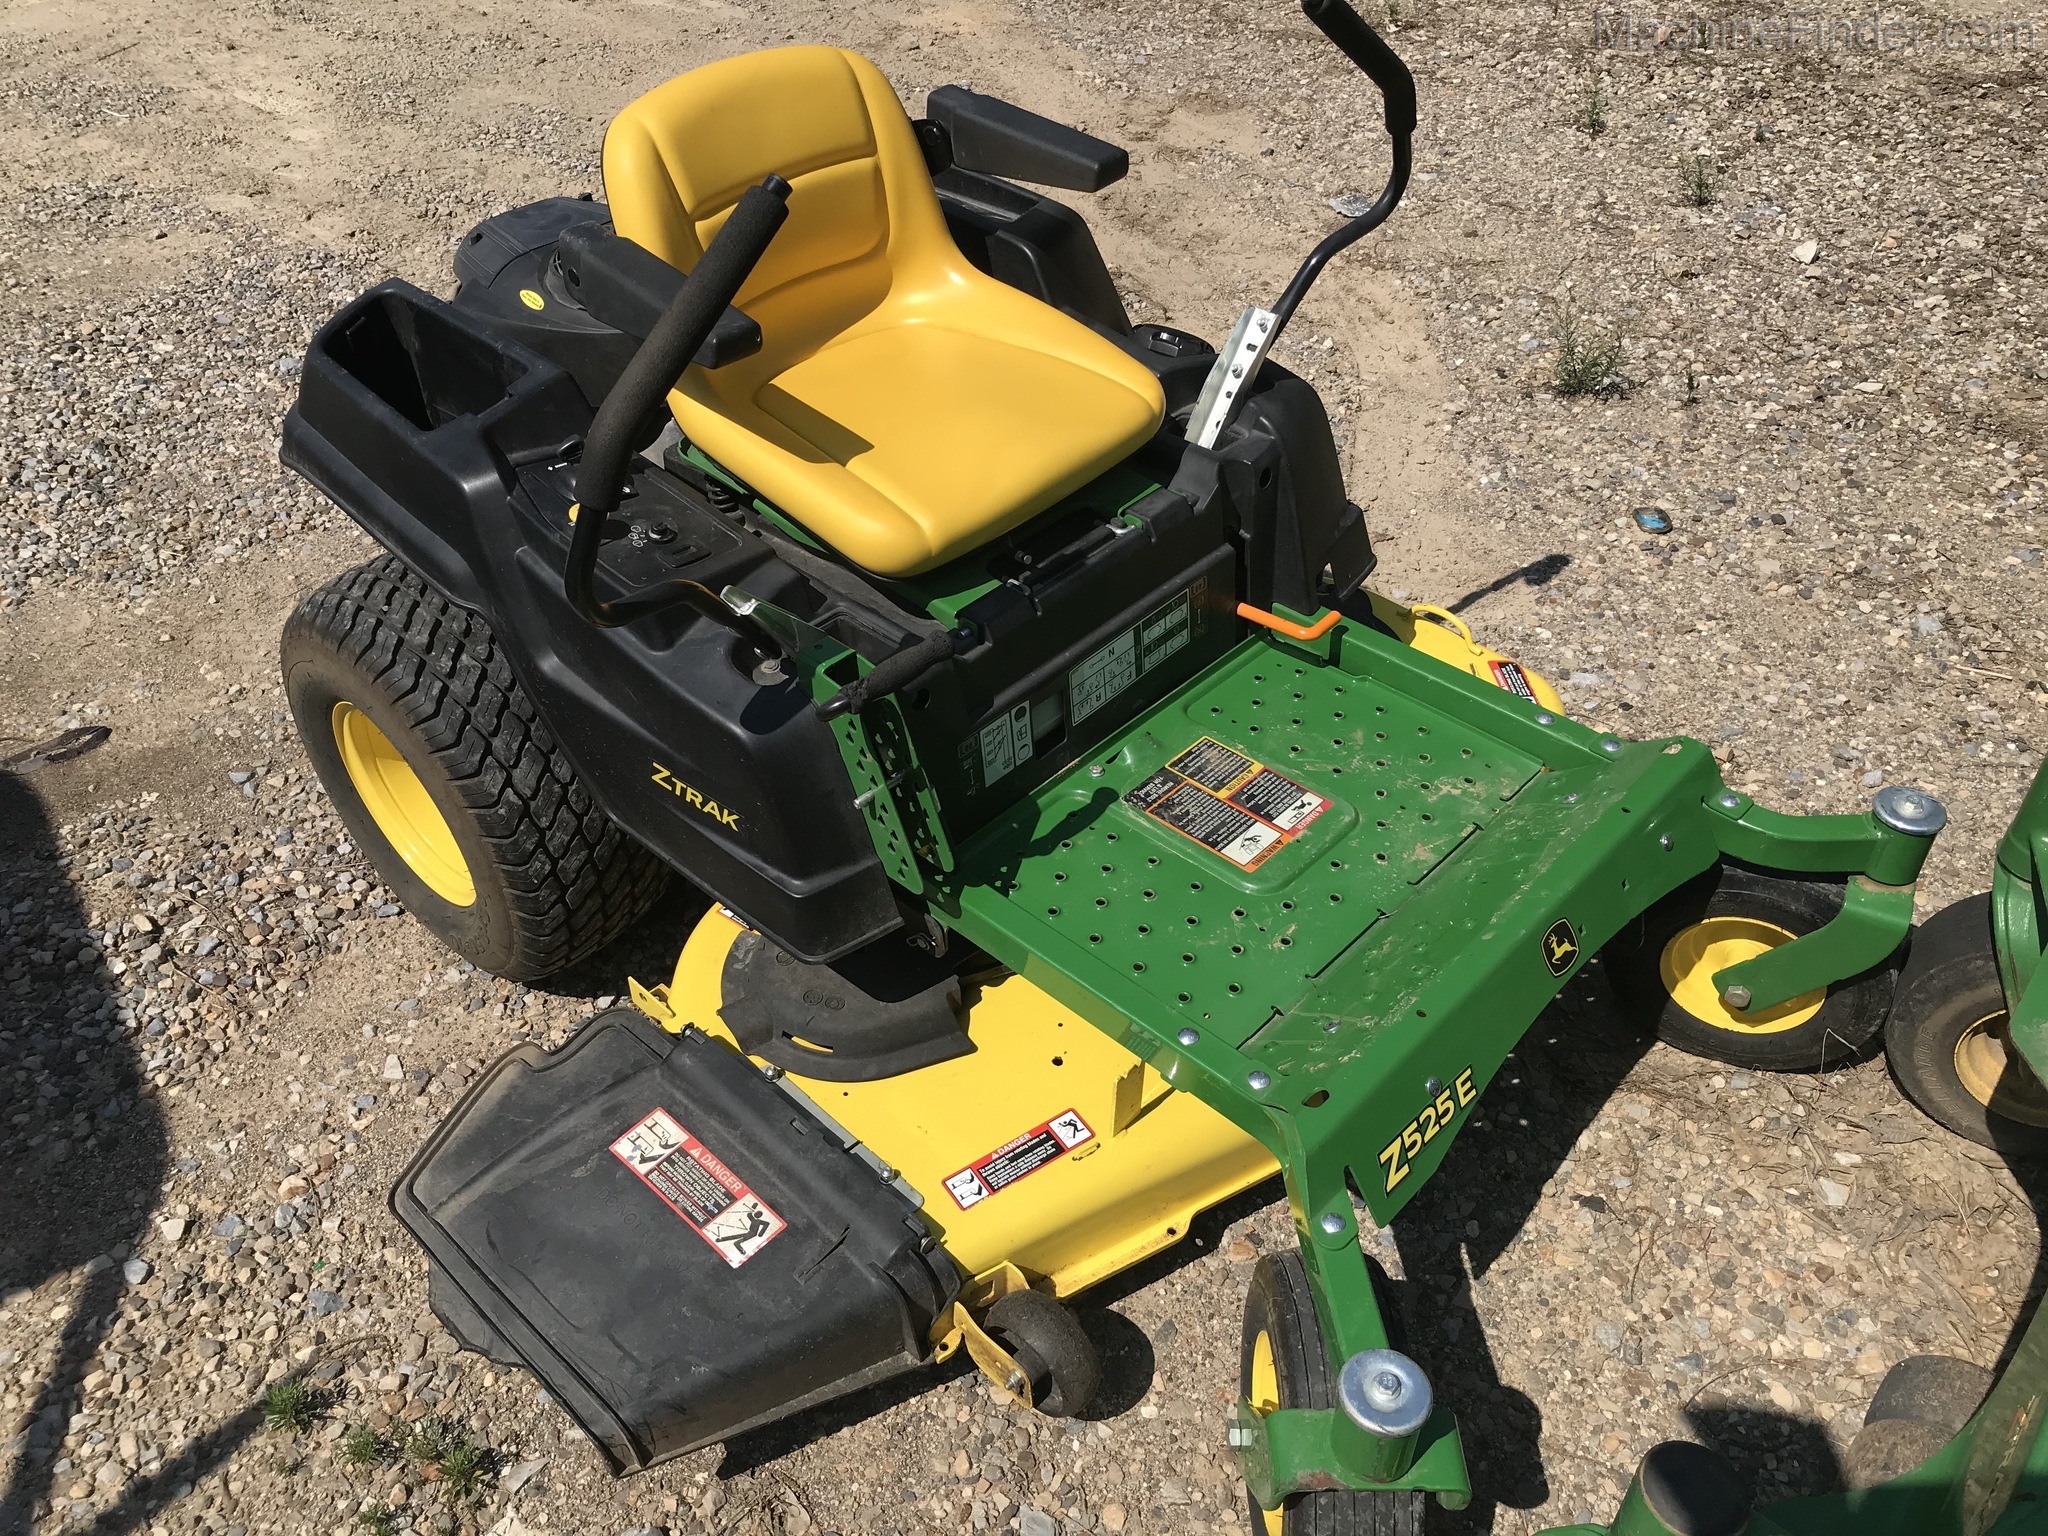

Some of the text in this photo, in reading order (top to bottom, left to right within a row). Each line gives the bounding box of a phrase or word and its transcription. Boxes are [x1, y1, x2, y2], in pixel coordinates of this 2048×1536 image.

[1224, 773, 1250, 792] CAUTION
[651, 761, 740, 832] ZTRAK
[1293, 810, 1320, 829] DANGER
[1250, 843, 1279, 866] WARNING
[996, 1132, 1032, 1155] DANGER
[699, 1152, 743, 1193] DANGER
